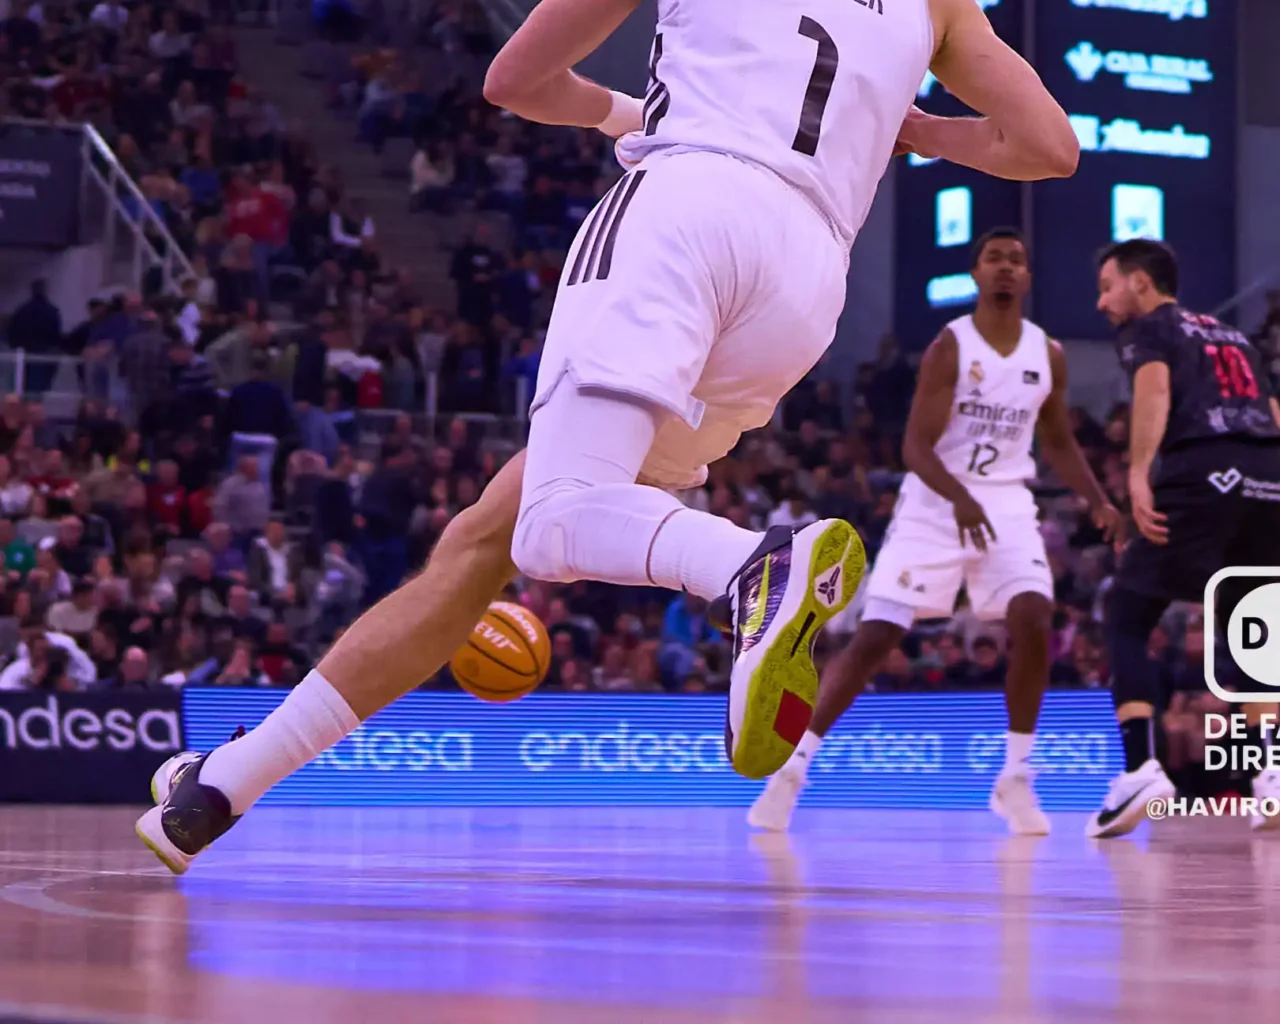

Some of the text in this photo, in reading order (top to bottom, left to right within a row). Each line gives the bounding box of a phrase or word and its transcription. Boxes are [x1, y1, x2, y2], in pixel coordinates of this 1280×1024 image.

[791, 14, 839, 157] 1
[967, 442, 999, 476] 12
[0, 693, 181, 751] ndesa
[518, 720, 730, 772] endesa
